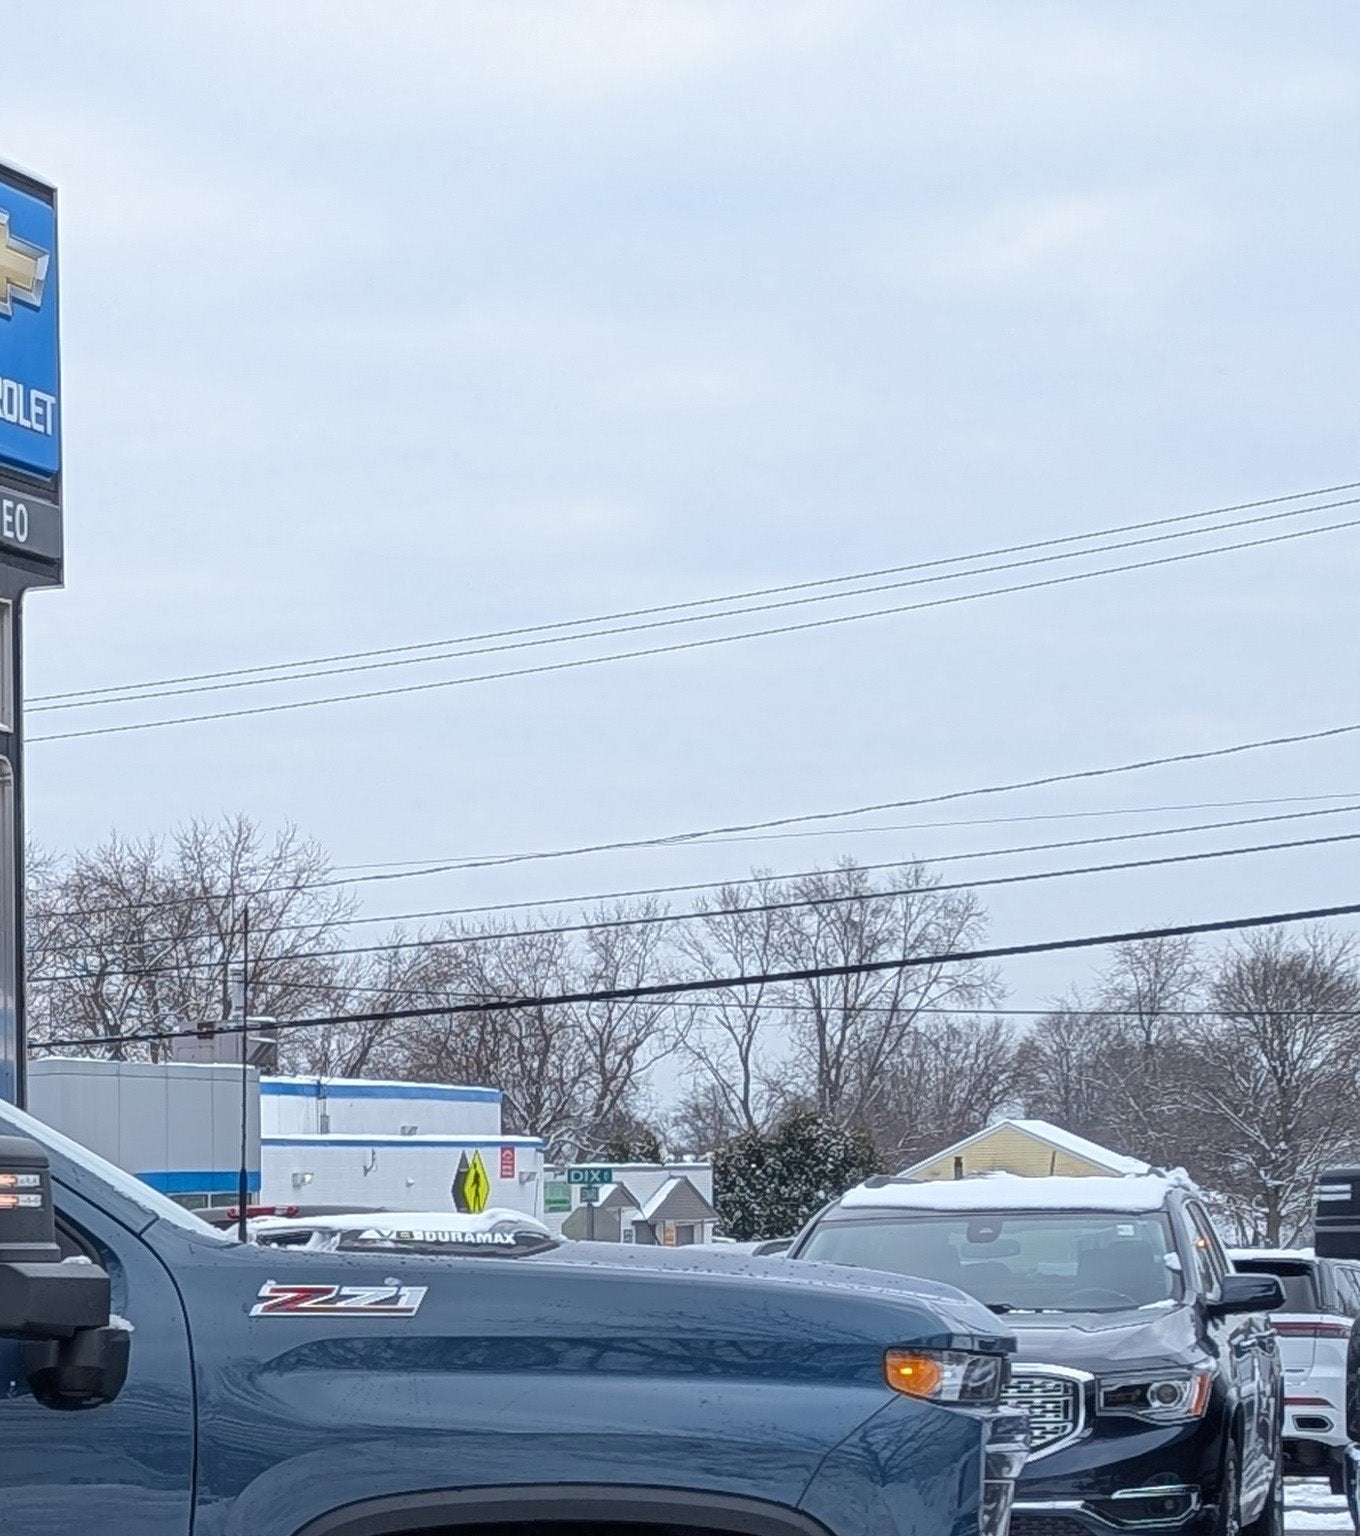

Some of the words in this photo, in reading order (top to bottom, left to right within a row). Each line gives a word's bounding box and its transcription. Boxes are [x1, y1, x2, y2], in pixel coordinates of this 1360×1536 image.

[570, 1170, 601, 1182] DIX
[424, 1231, 517, 1245] DURAMAX
[249, 1283, 429, 1317] Z71
